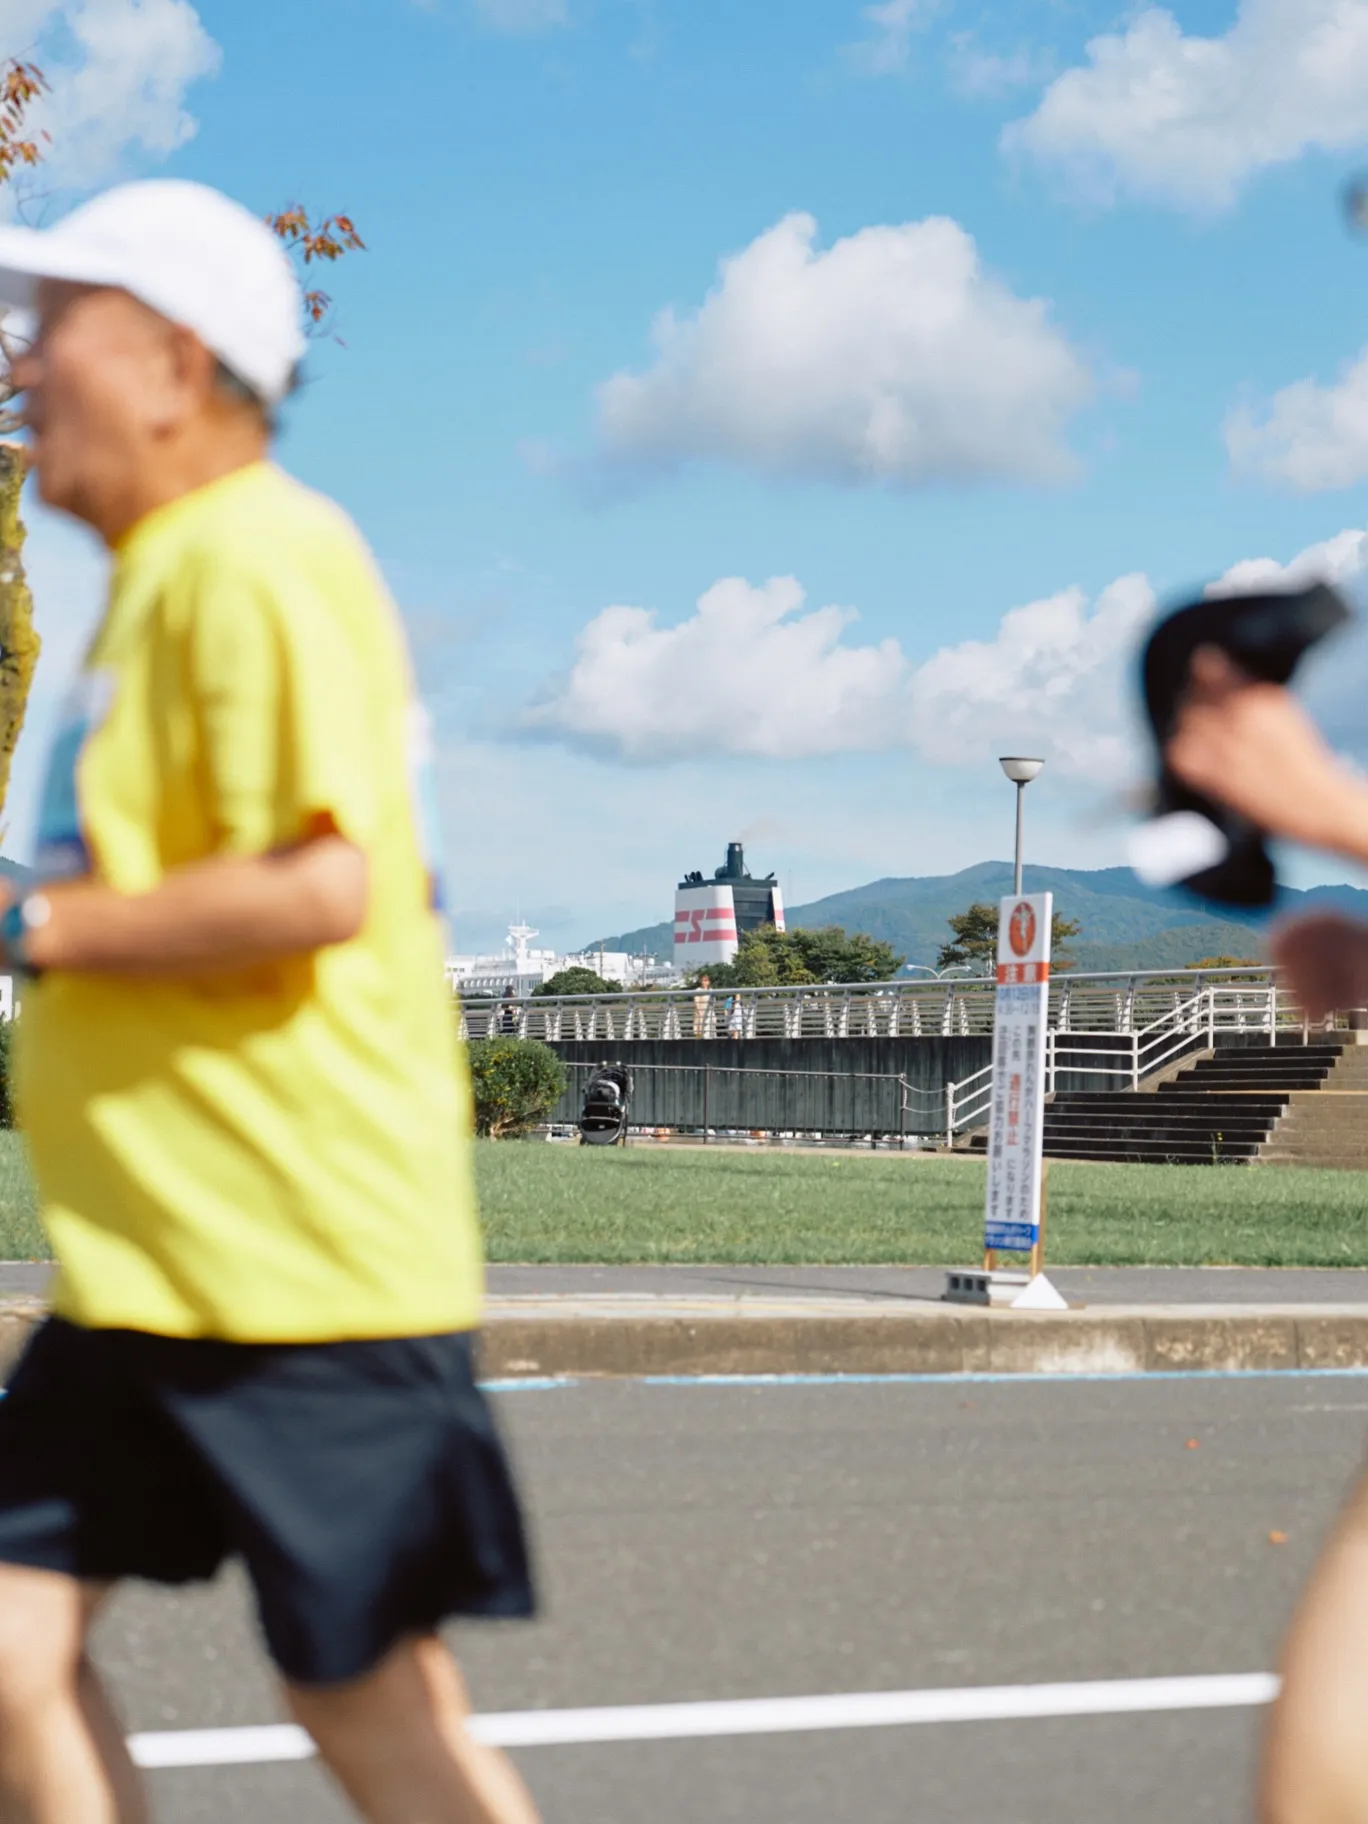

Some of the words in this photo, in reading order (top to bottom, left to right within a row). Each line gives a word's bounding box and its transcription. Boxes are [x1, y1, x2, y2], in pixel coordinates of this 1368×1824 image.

[1019, 1025, 1036, 1220] れんがハーフマラソンのため
